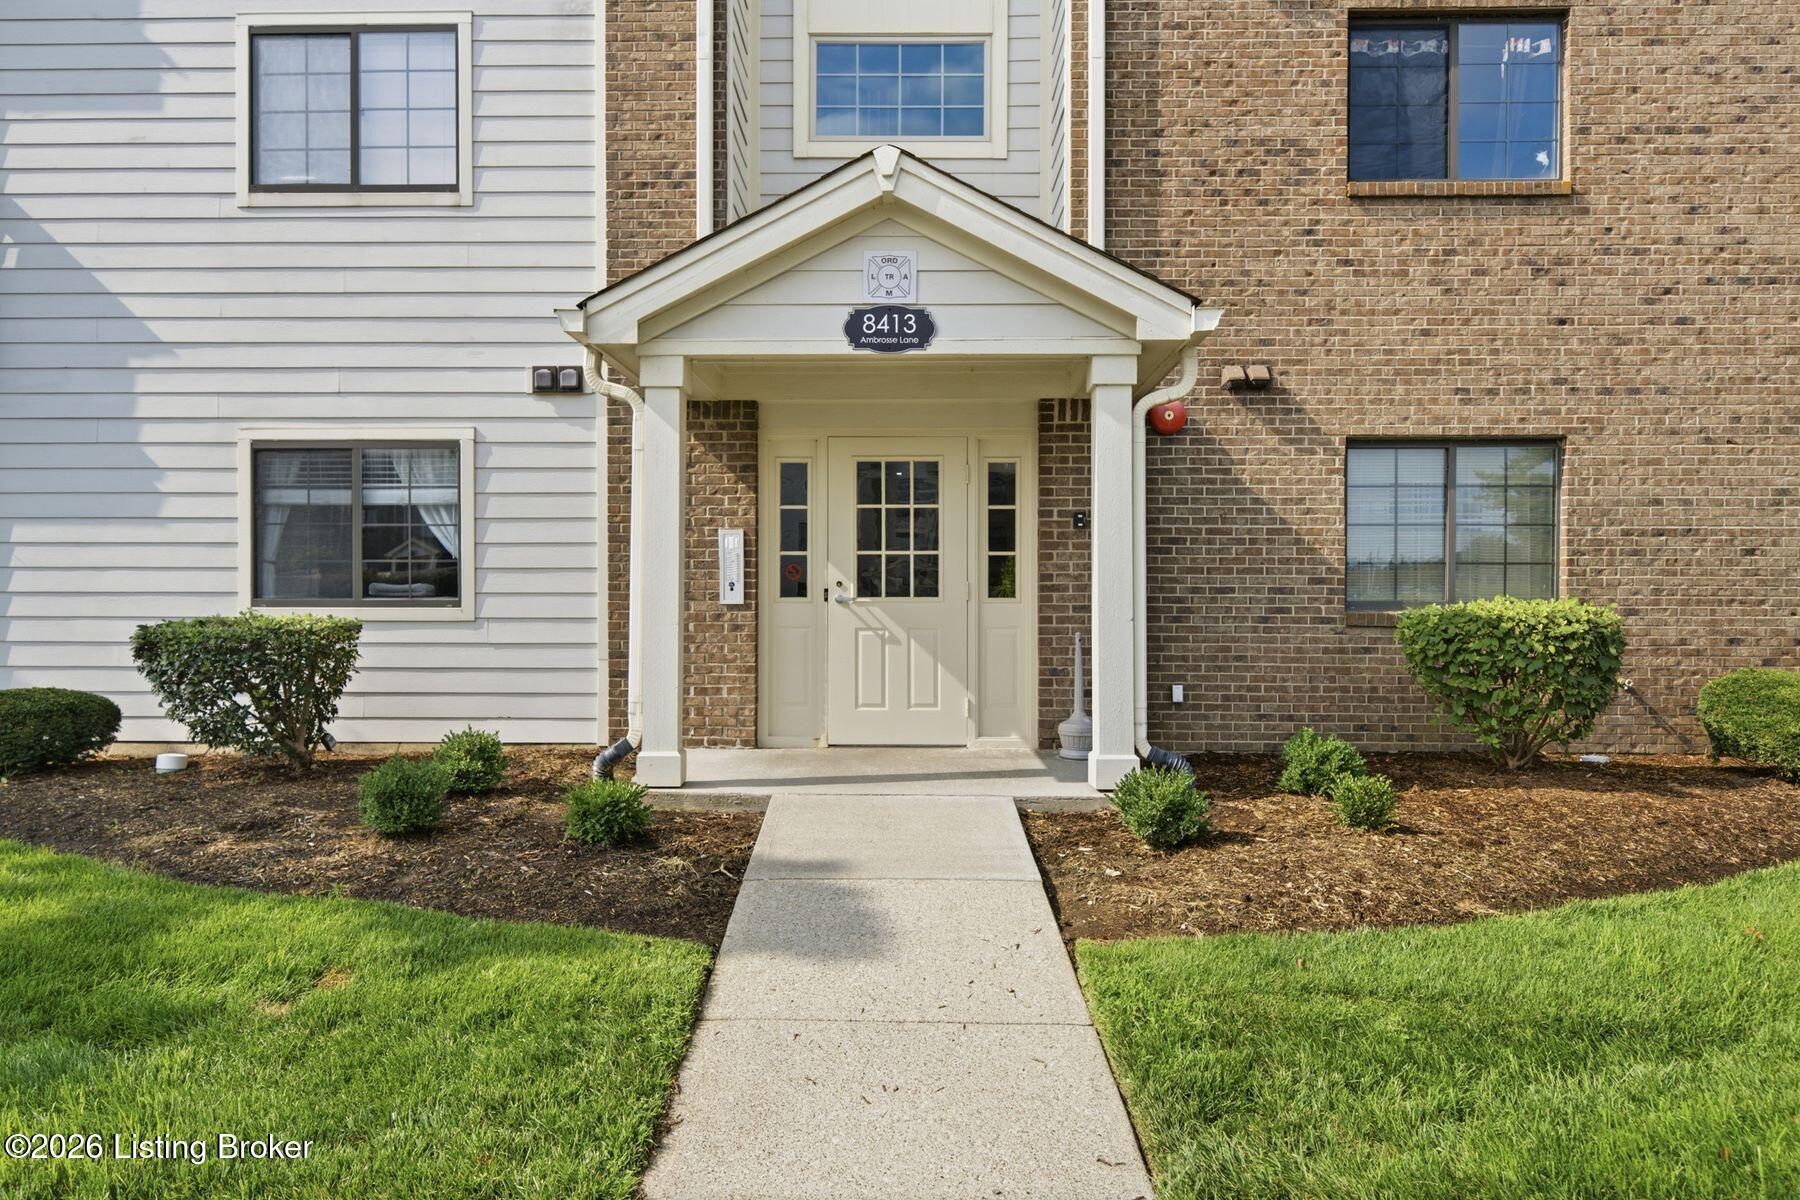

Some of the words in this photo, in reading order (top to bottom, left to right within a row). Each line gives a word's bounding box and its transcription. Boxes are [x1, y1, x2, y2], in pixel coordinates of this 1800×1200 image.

[863, 314, 916, 333] 8413
[860, 336, 898, 344] Ambrosse
[899, 336, 919, 344] Lane
